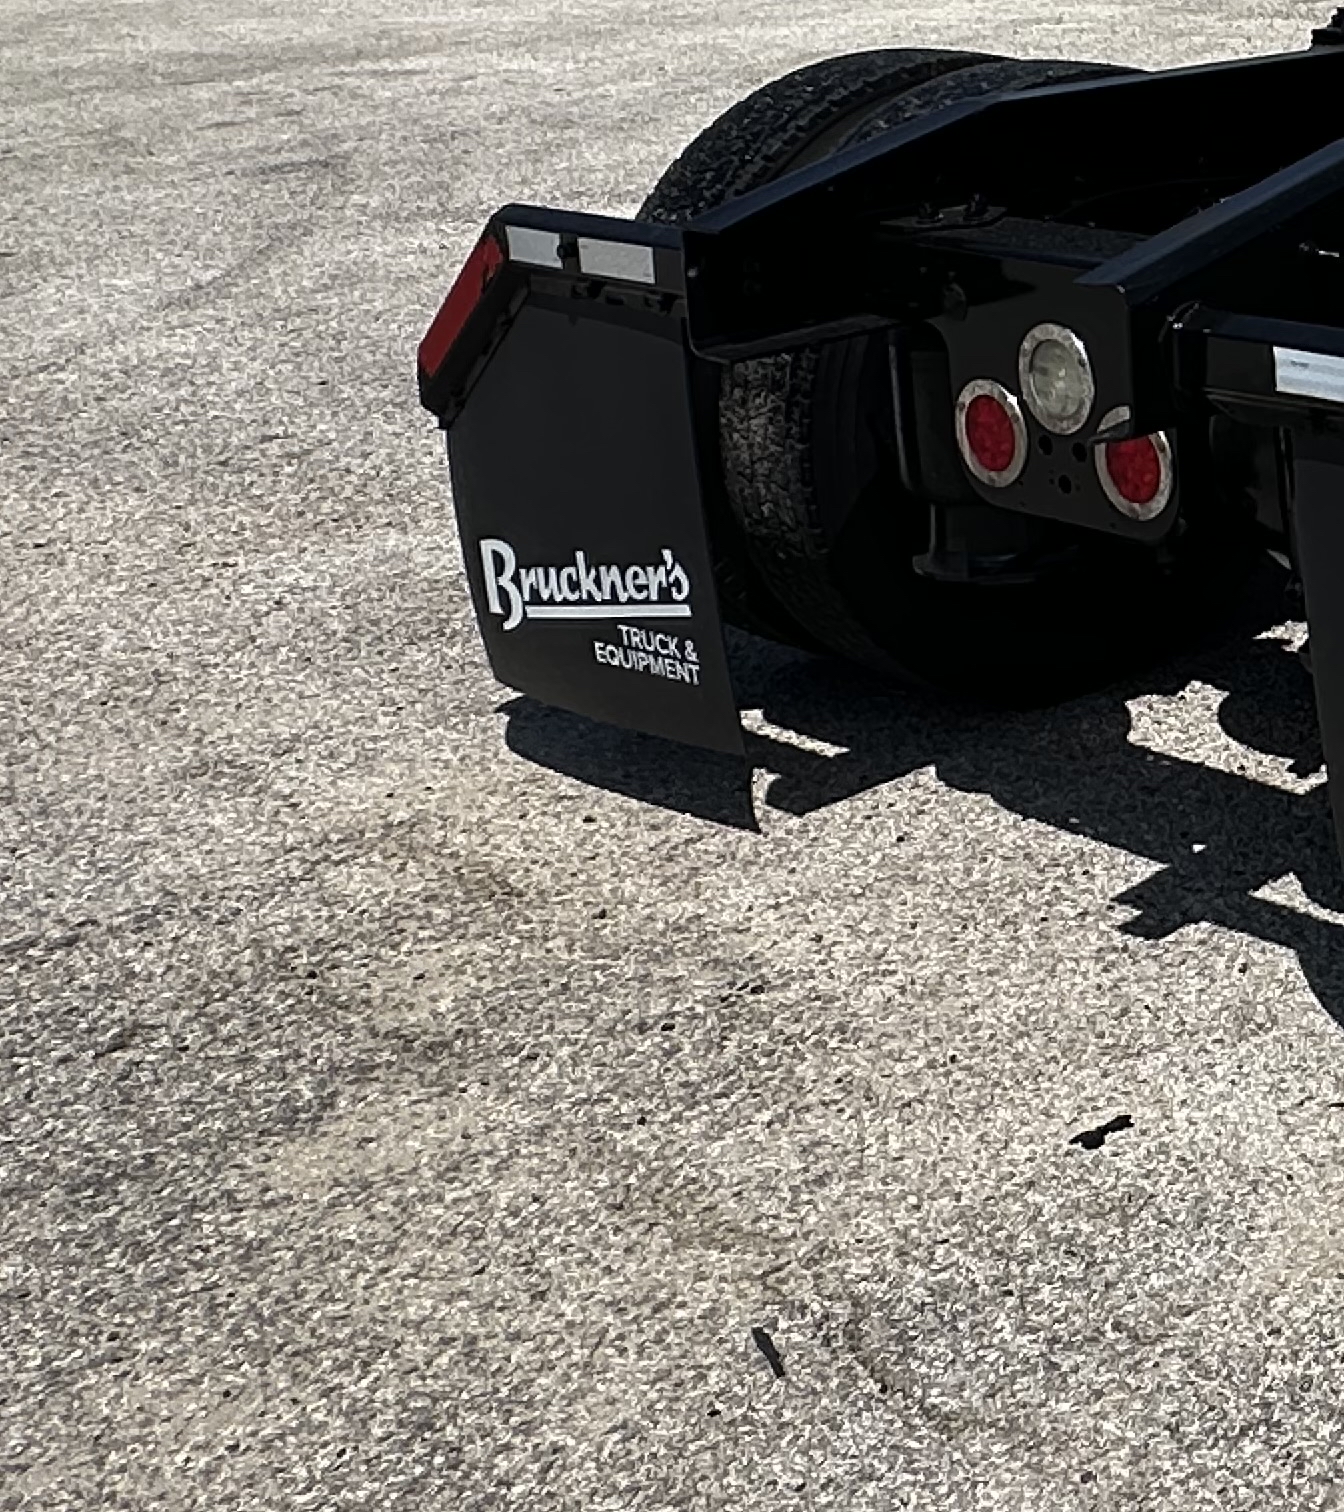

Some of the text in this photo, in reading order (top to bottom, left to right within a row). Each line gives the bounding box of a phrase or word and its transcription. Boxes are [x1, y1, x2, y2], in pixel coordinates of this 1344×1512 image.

[479, 538, 690, 631] Bruckner's
[594, 640, 700, 686] EQUIPMENT
[616, 624, 700, 663] TRUCK &
